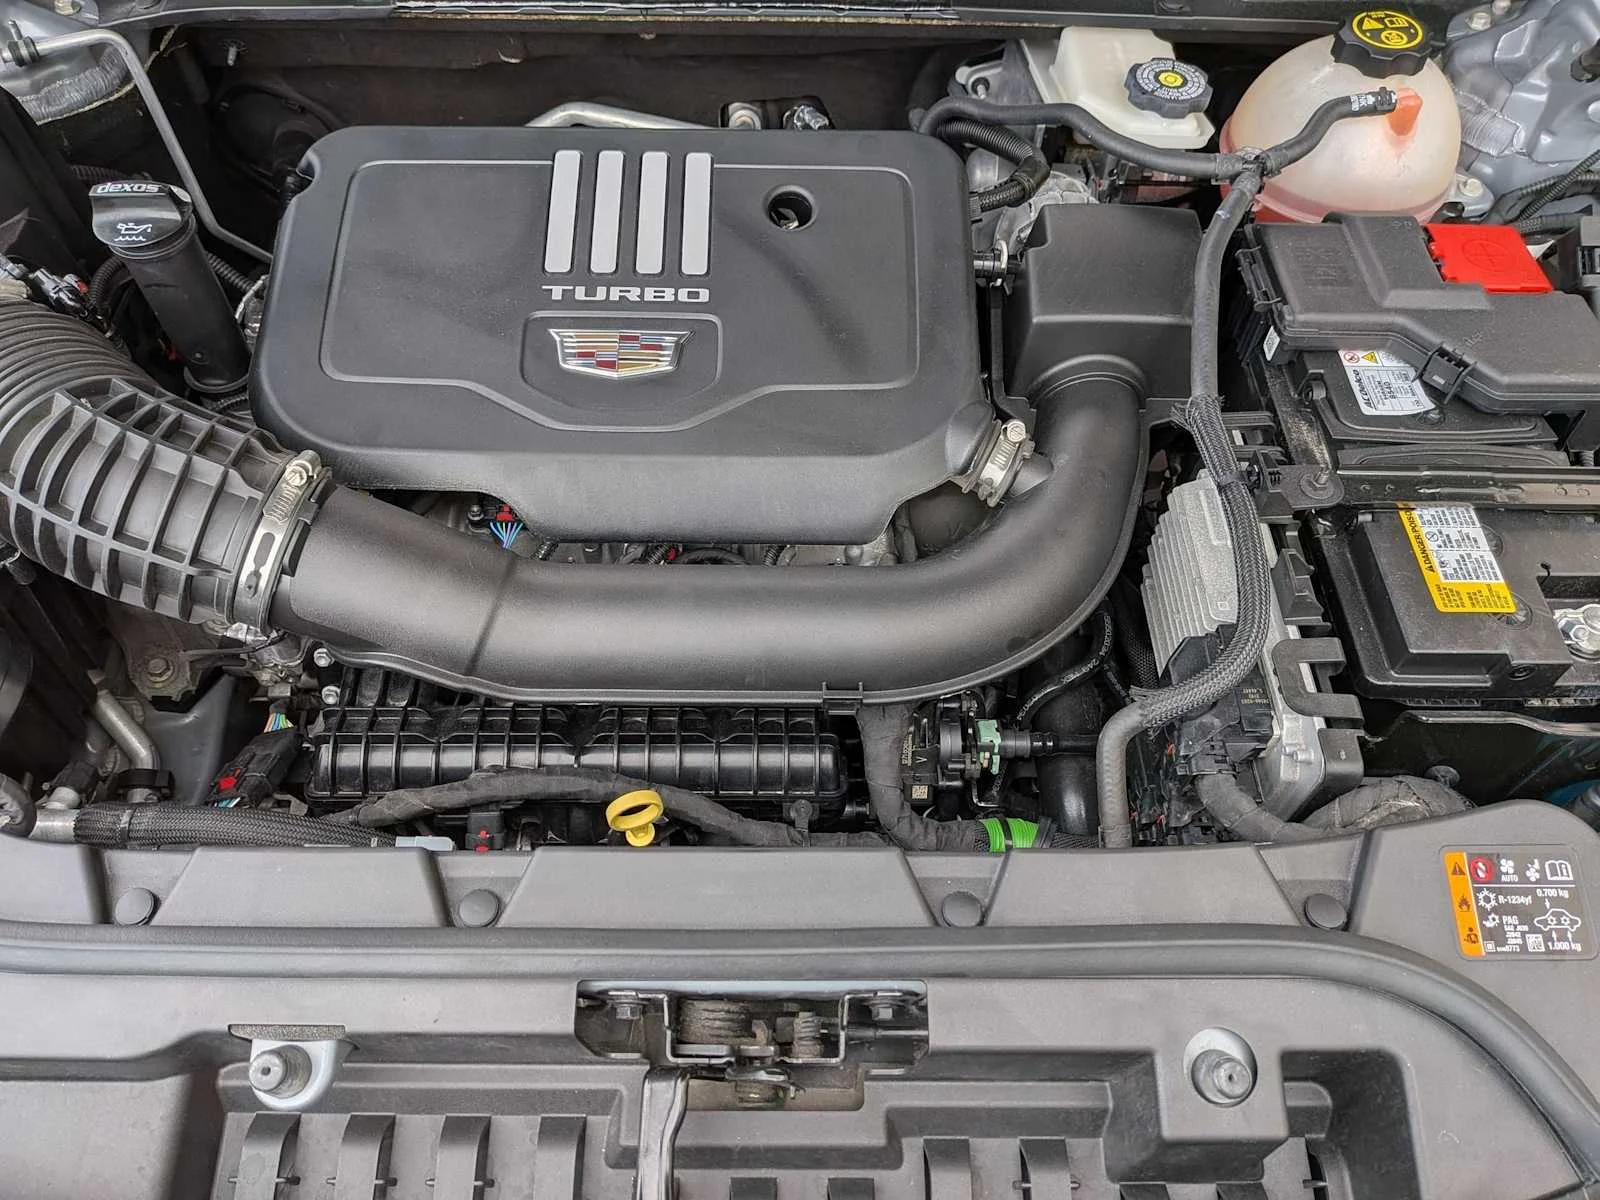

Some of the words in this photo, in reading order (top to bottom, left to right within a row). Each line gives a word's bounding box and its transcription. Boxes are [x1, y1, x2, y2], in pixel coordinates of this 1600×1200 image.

[97, 182, 161, 194] dexos
[541, 285, 710, 303] TURBO
[1353, 369, 1373, 409] ACDelco
[1405, 510, 1433, 565] DANGER/POISO
[1536, 889, 1557, 897] 0.700
[1559, 889, 1569, 899] kg
[1502, 916, 1519, 925] PAG
[1548, 941, 1569, 951] 1.000
[1571, 942, 1582, 952] kg
